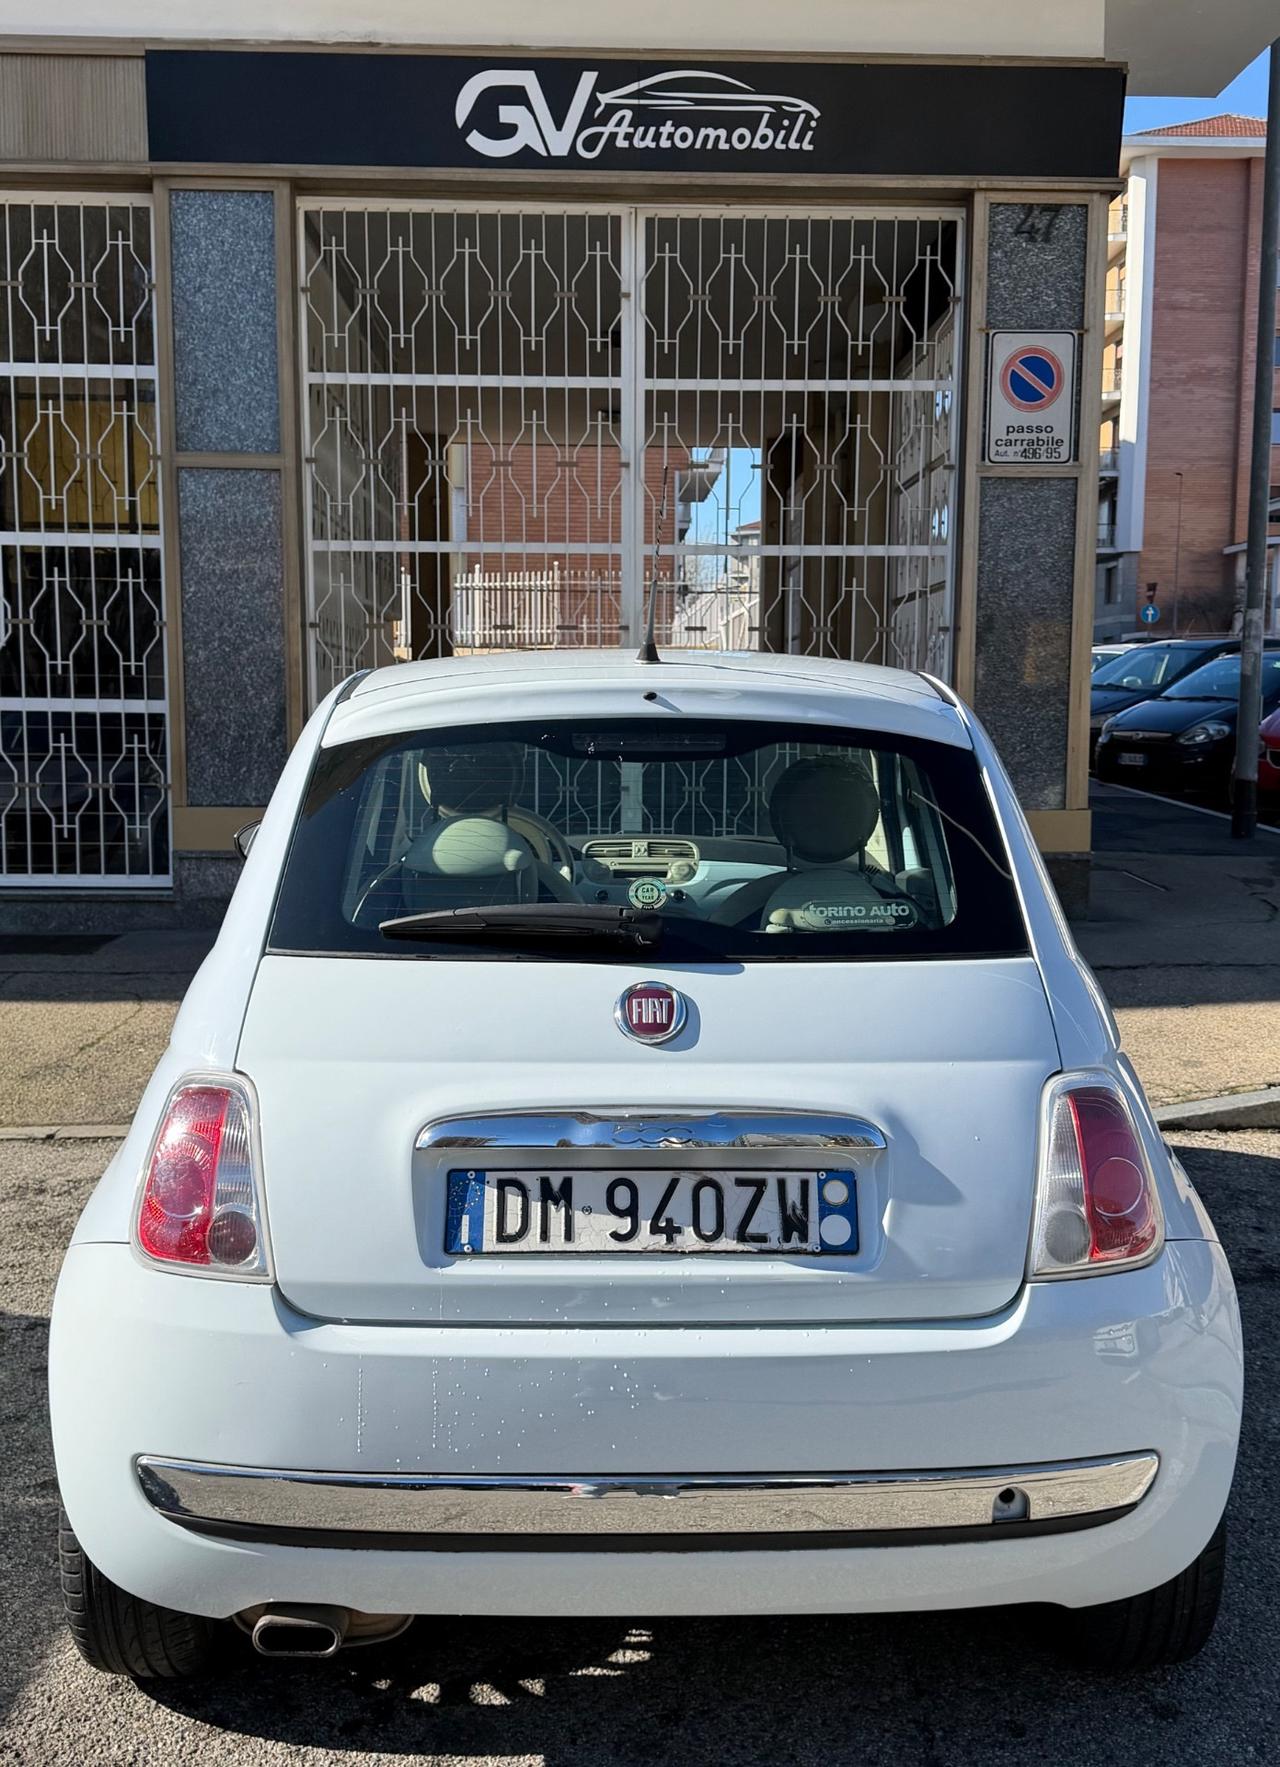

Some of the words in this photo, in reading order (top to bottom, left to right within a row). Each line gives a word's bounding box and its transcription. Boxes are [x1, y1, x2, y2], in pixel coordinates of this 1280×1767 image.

[455, 69, 599, 158] GV
[576, 108, 818, 159] Automobili
[1013, 204, 1061, 243] 47
[994, 436, 1065, 448] carrabile
[1006, 425, 1054, 437] passo
[632, 997, 672, 1025] FIAT
[495, 1176, 574, 1244] DM
[605, 1177, 810, 1245] 940ZW
